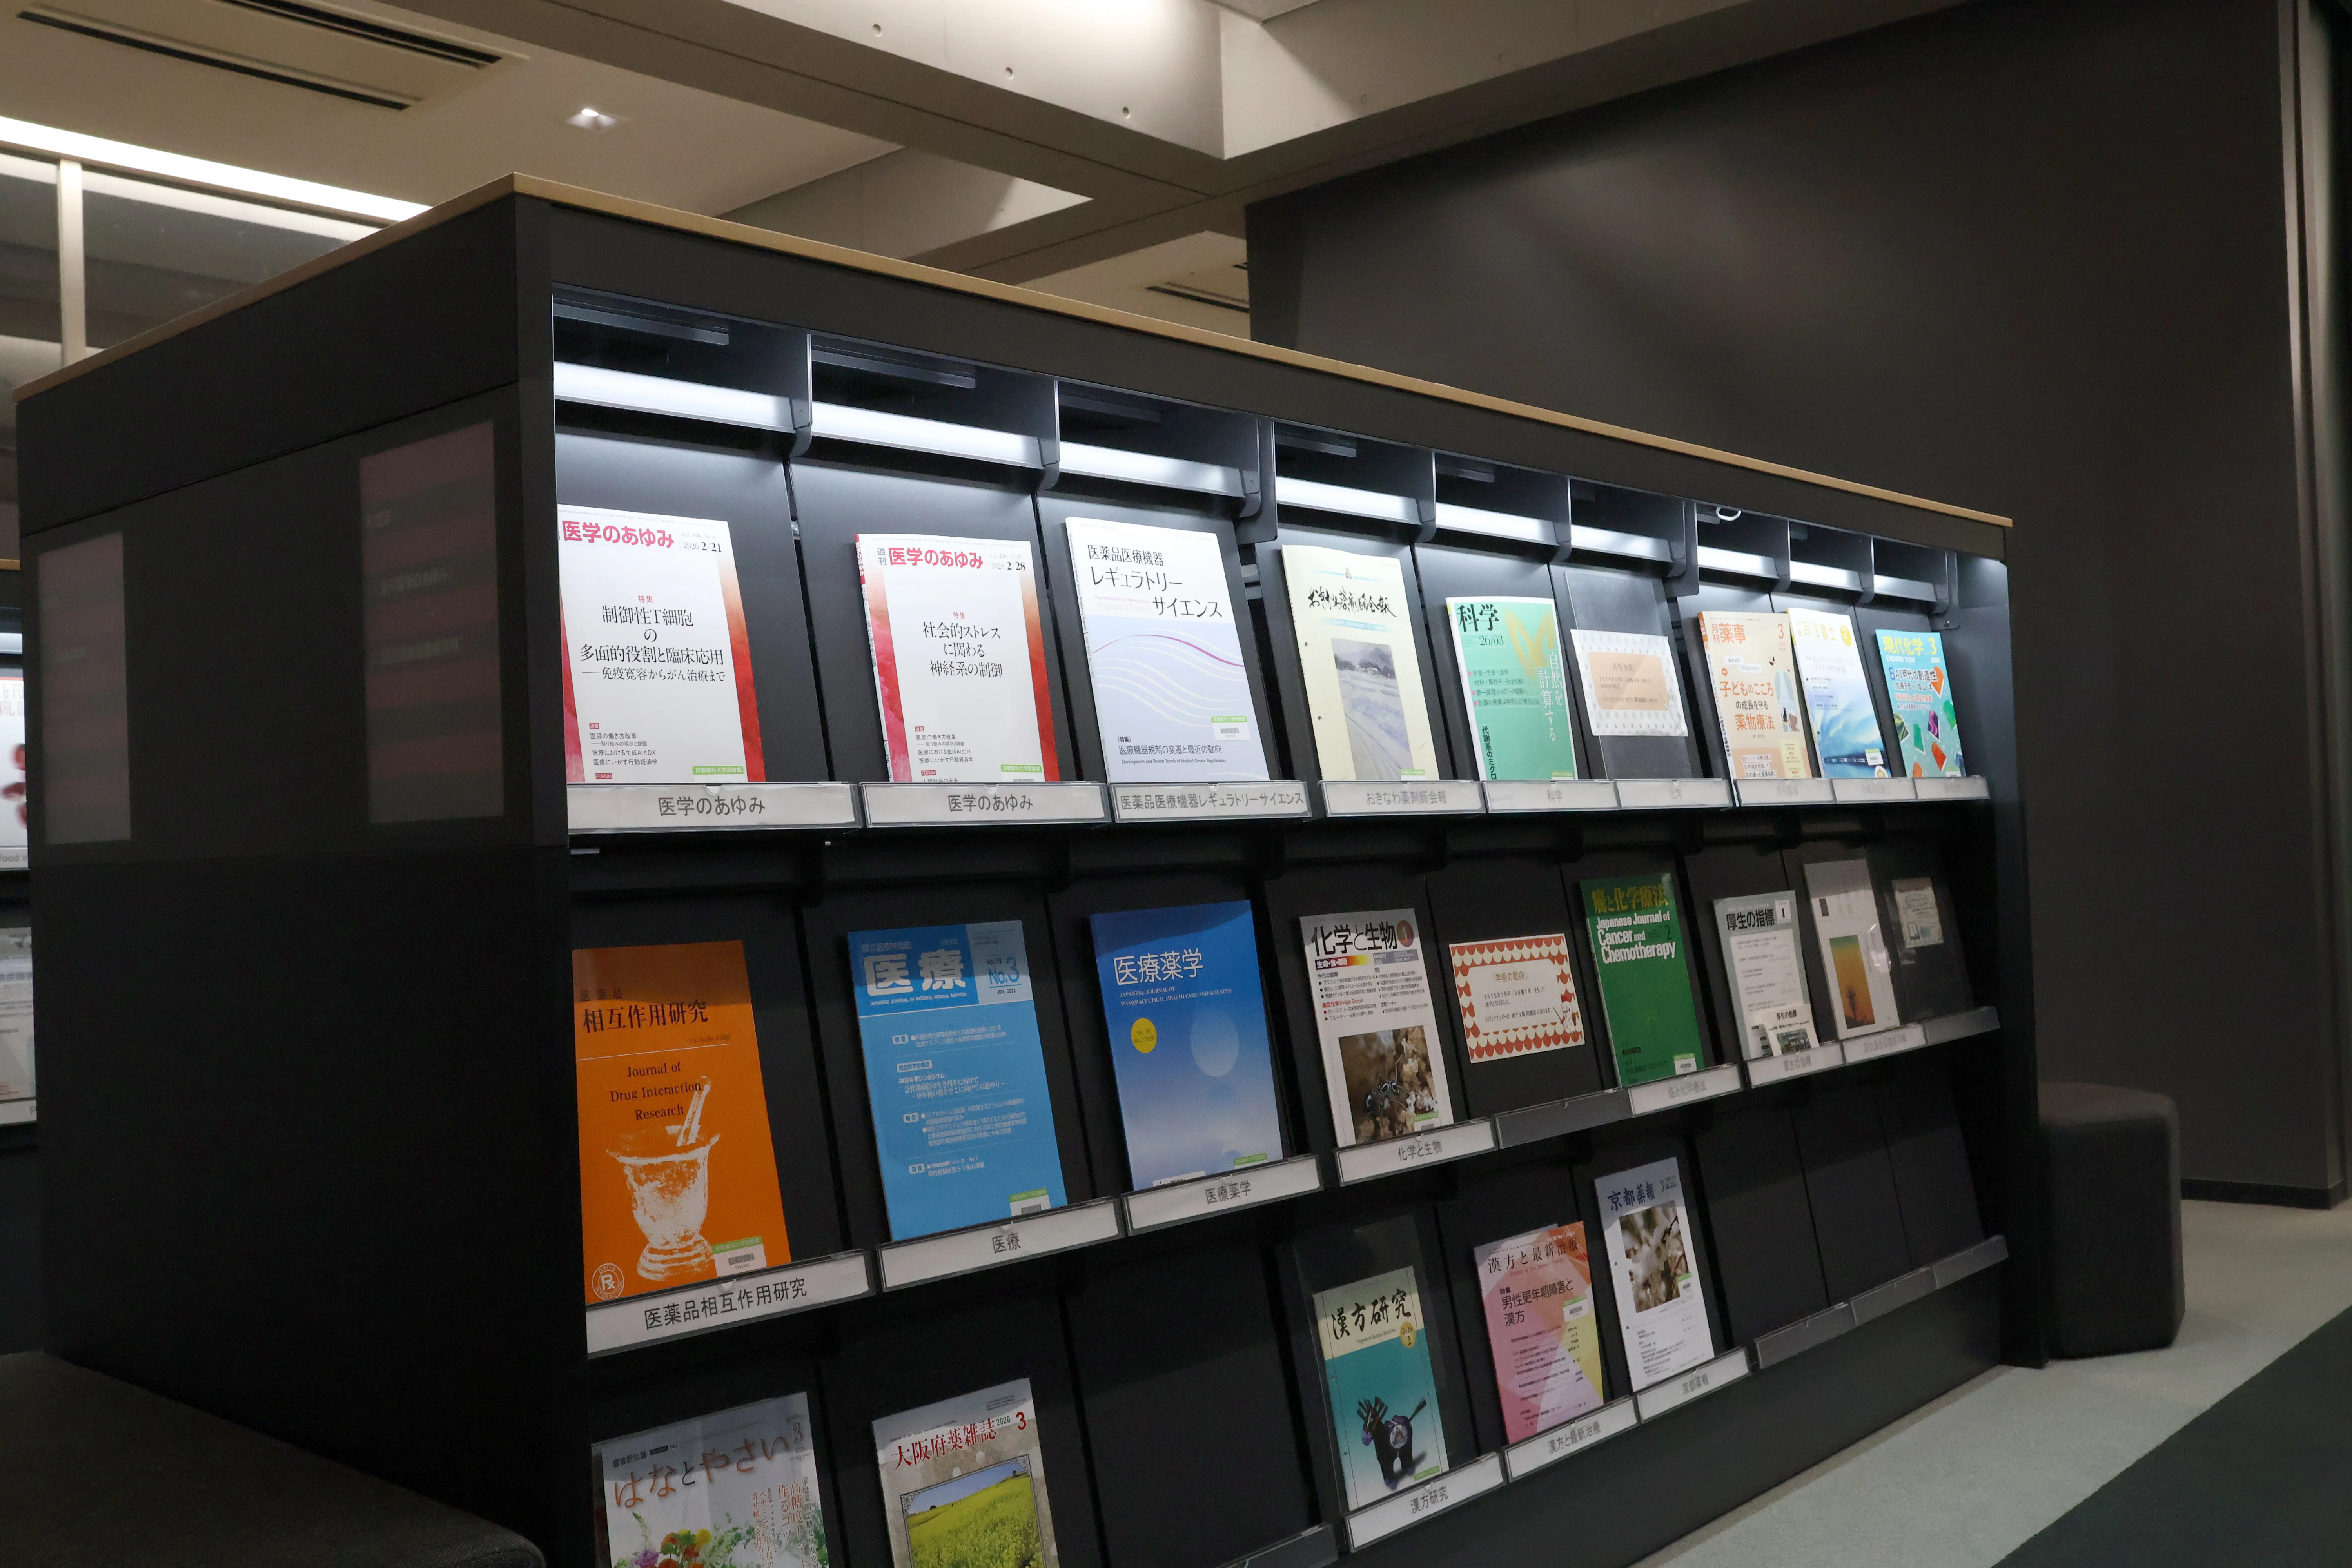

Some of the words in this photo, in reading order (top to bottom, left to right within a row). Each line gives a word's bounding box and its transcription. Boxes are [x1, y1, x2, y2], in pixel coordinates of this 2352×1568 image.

[562, 521, 674, 548] 医学のあゆみ
[684, 542, 699, 550] 2026
[702, 542, 723, 552] 2/21
[1087, 544, 1164, 566] 医薬品医療機器
[888, 547, 983, 569] 医学のあゆみ
[1007, 562, 1026, 571] 2/28
[1091, 566, 1183, 592] レギュラトリー
[637, 595, 653, 604] 特集
[1097, 601, 1129, 612] Regulatory
[1153, 596, 1223, 618] サイエンス
[601, 605, 693, 627] 制御性T細胞
[1456, 603, 1499, 632] 科学
[644, 629, 657, 642] の
[922, 622, 1001, 639] 社会的ストレス
[1479, 635, 1504, 646] 26/03
[1719, 622, 1746, 644] 薬事
[1778, 623, 1784, 639] 3
[580, 644, 724, 666] 多面的役割と臨床応用
[944, 642, 985, 657] に関わる
[1882, 636, 1924, 656] 現代化学
[1928, 637, 1937, 655] 3
[929, 660, 1003, 678] 神経系の制御
[1549, 651, 1563, 706] 自然を
[1720, 680, 1774, 698] 子どものこころ
[1537, 670, 1558, 742] 計算する
[1735, 700, 1768, 710] の成長を守る
[1735, 713, 1775, 731] 薬物療法
[1119, 744, 1222, 755] 医療機器規制の変遷と最近の動向
[659, 797, 766, 816] 医学のあゆみ
[949, 795, 1033, 811] 医学のあゆみ
[1120, 792, 1304, 810] 医薬品医療機器レギュラトリーサイエンス
[1366, 790, 1447, 805] おきなわ薬剤師会報
[1596, 916, 1632, 930] Japanese
[1633, 910, 1662, 924] Journal
[1663, 911, 1670, 921] of
[1726, 908, 1775, 931] 厚生の指標
[1781, 907, 1785, 918] 1
[1311, 921, 1397, 957] 化学と生物
[1597, 929, 1633, 946] Cancer
[1634, 931, 1646, 941] and
[1601, 942, 1676, 964] Chemotherapy
[864, 949, 966, 996] 医療
[989, 956, 1019, 984] No.3
[1114, 948, 1204, 985] 医療薬学
[1121, 997, 1165, 1007] PHARMACEUTICAL
[583, 999, 708, 1034] 相互作用研究
[627, 1063, 667, 1078] Journal
[671, 1062, 681, 1072] of
[610, 1090, 638, 1102] Drug
[642, 1081, 701, 1098] Interaction
[635, 1104, 684, 1121] Research
[1398, 1140, 1443, 1161] 化学と生物
[1205, 1180, 1252, 1205] 医療薬学
[1607, 1182, 1655, 1212] 京都薬報
[992, 1232, 1021, 1254] 医療
[1488, 1238, 1578, 1274] 漢方と最新治療
[598, 1265, 616, 1274] DRUG
[644, 1277, 807, 1330] 医薬品相互作用研究
[1501, 1279, 1573, 1310] 男性更年期障害と
[1331, 1288, 1411, 1340] 漢方研究
[1504, 1310, 1524, 1327] 漢方
[892, 1417, 997, 1470] 大阪府薬雑誌
[996, 1415, 1011, 1426] 2026
[1015, 1412, 1027, 1430] 3
[614, 1436, 789, 1509] はなとやさい
[1410, 1486, 1449, 1514] 漢方研究
[777, 1484, 792, 1544] 作るコツ
